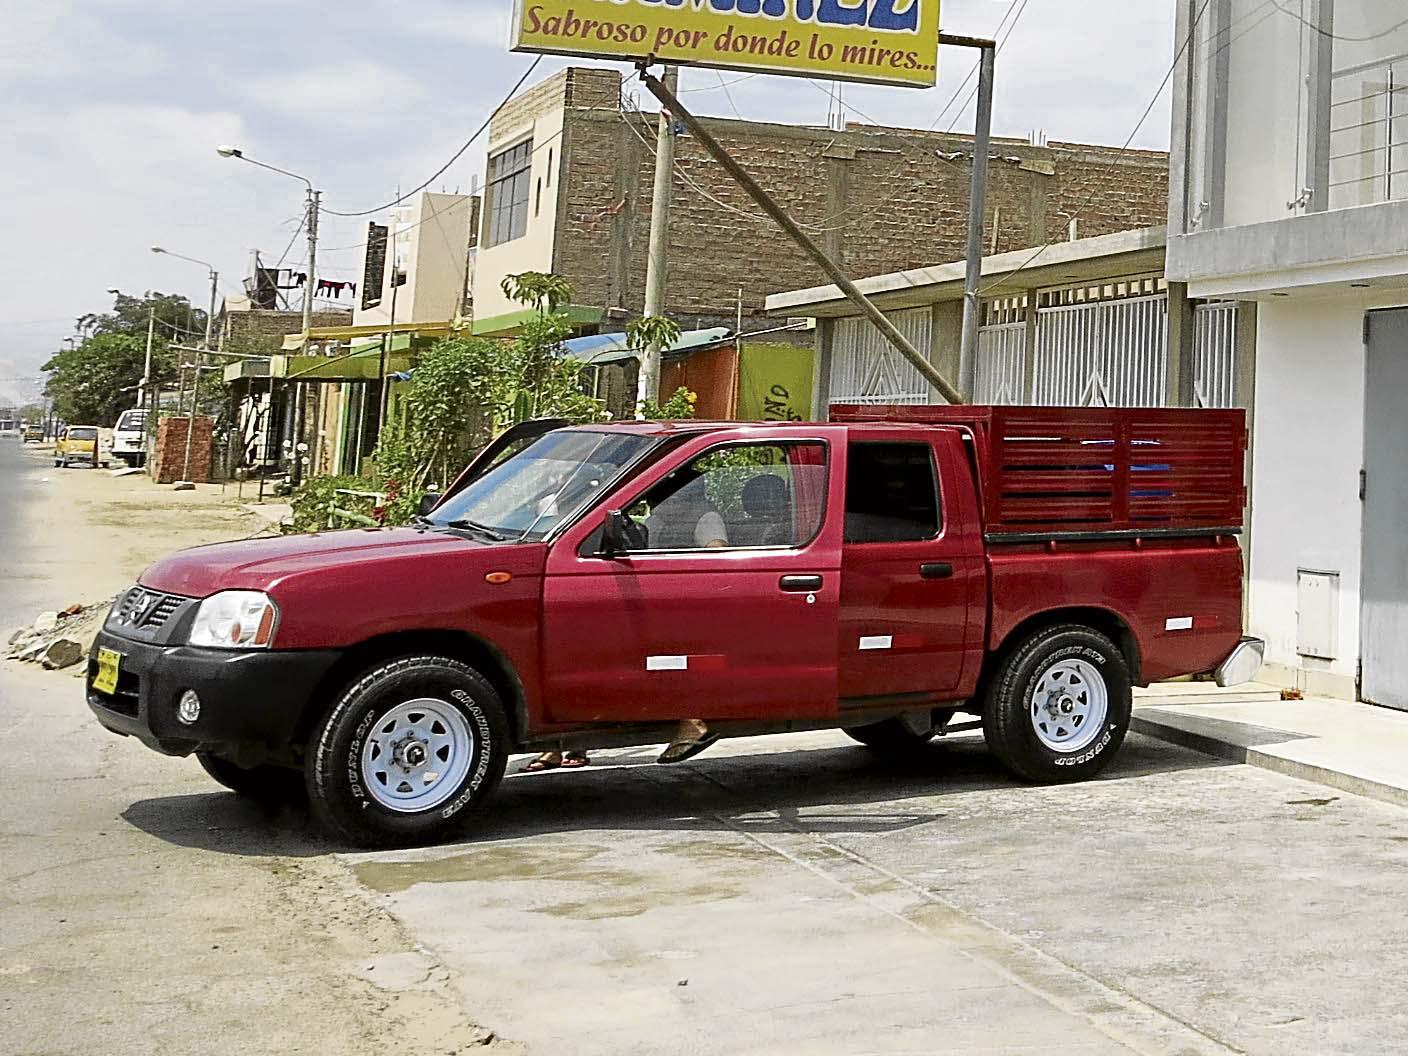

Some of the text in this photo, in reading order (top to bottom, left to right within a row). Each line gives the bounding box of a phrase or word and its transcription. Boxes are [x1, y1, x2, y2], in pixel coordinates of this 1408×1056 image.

[523, 6, 936, 71] Sabroso por donde lo mires...
[348, 709, 375, 797] DUNLOP
[1054, 731, 1112, 765] DUNLOP
